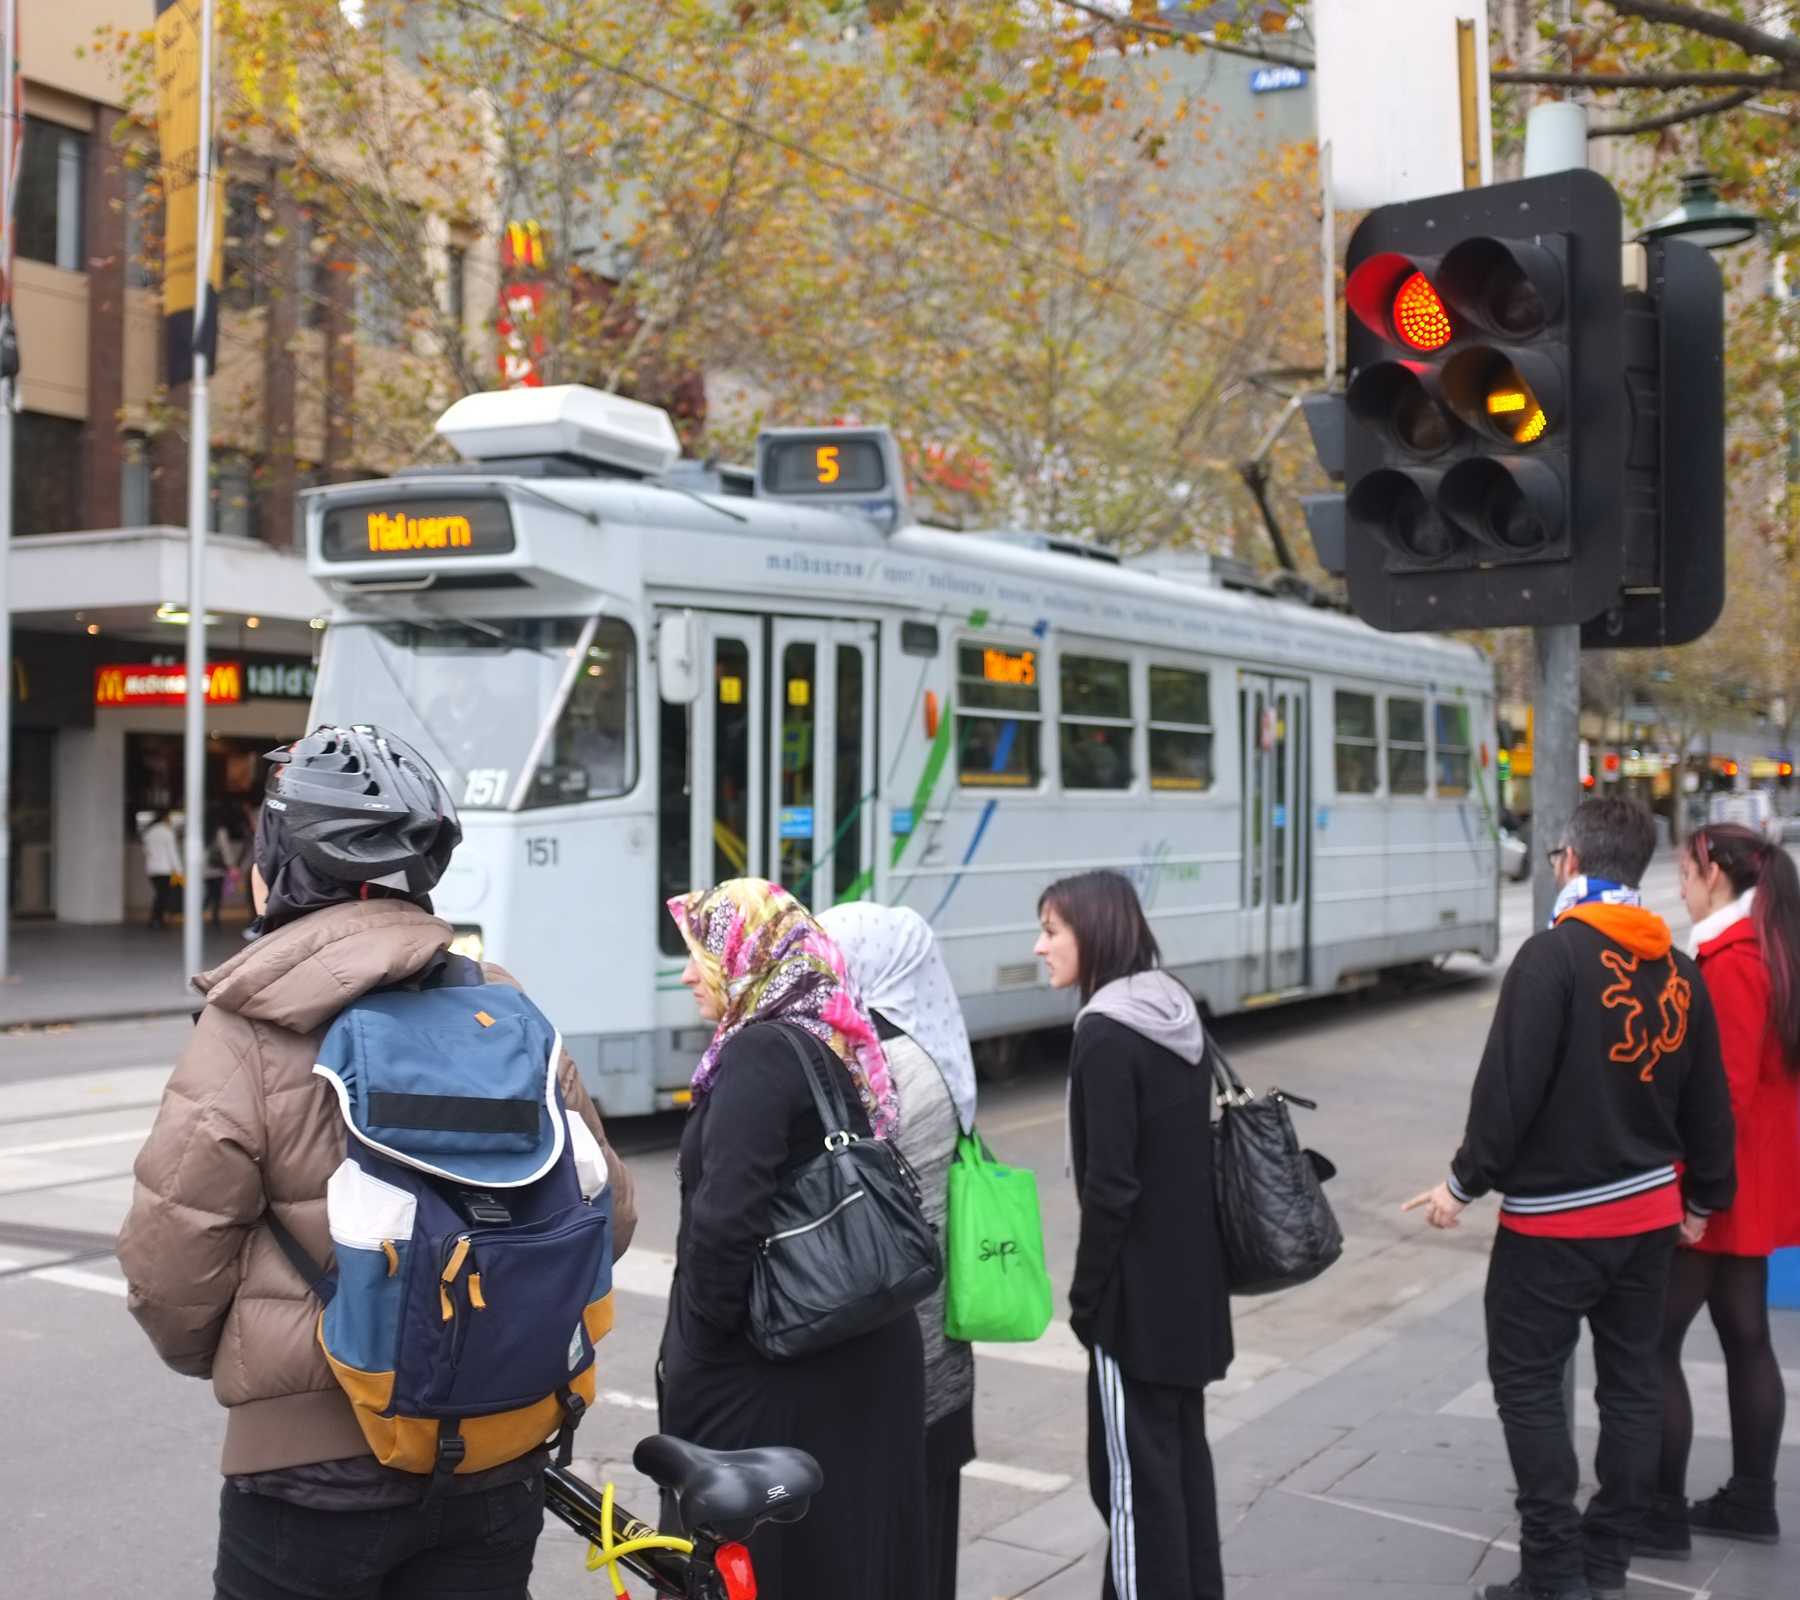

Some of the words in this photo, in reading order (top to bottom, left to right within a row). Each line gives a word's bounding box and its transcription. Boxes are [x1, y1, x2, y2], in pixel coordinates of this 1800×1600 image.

[816, 445, 840, 484] 5
[367, 512, 471, 551] Malvern
[463, 769, 508, 805] 151
[525, 837, 558, 867] 151
